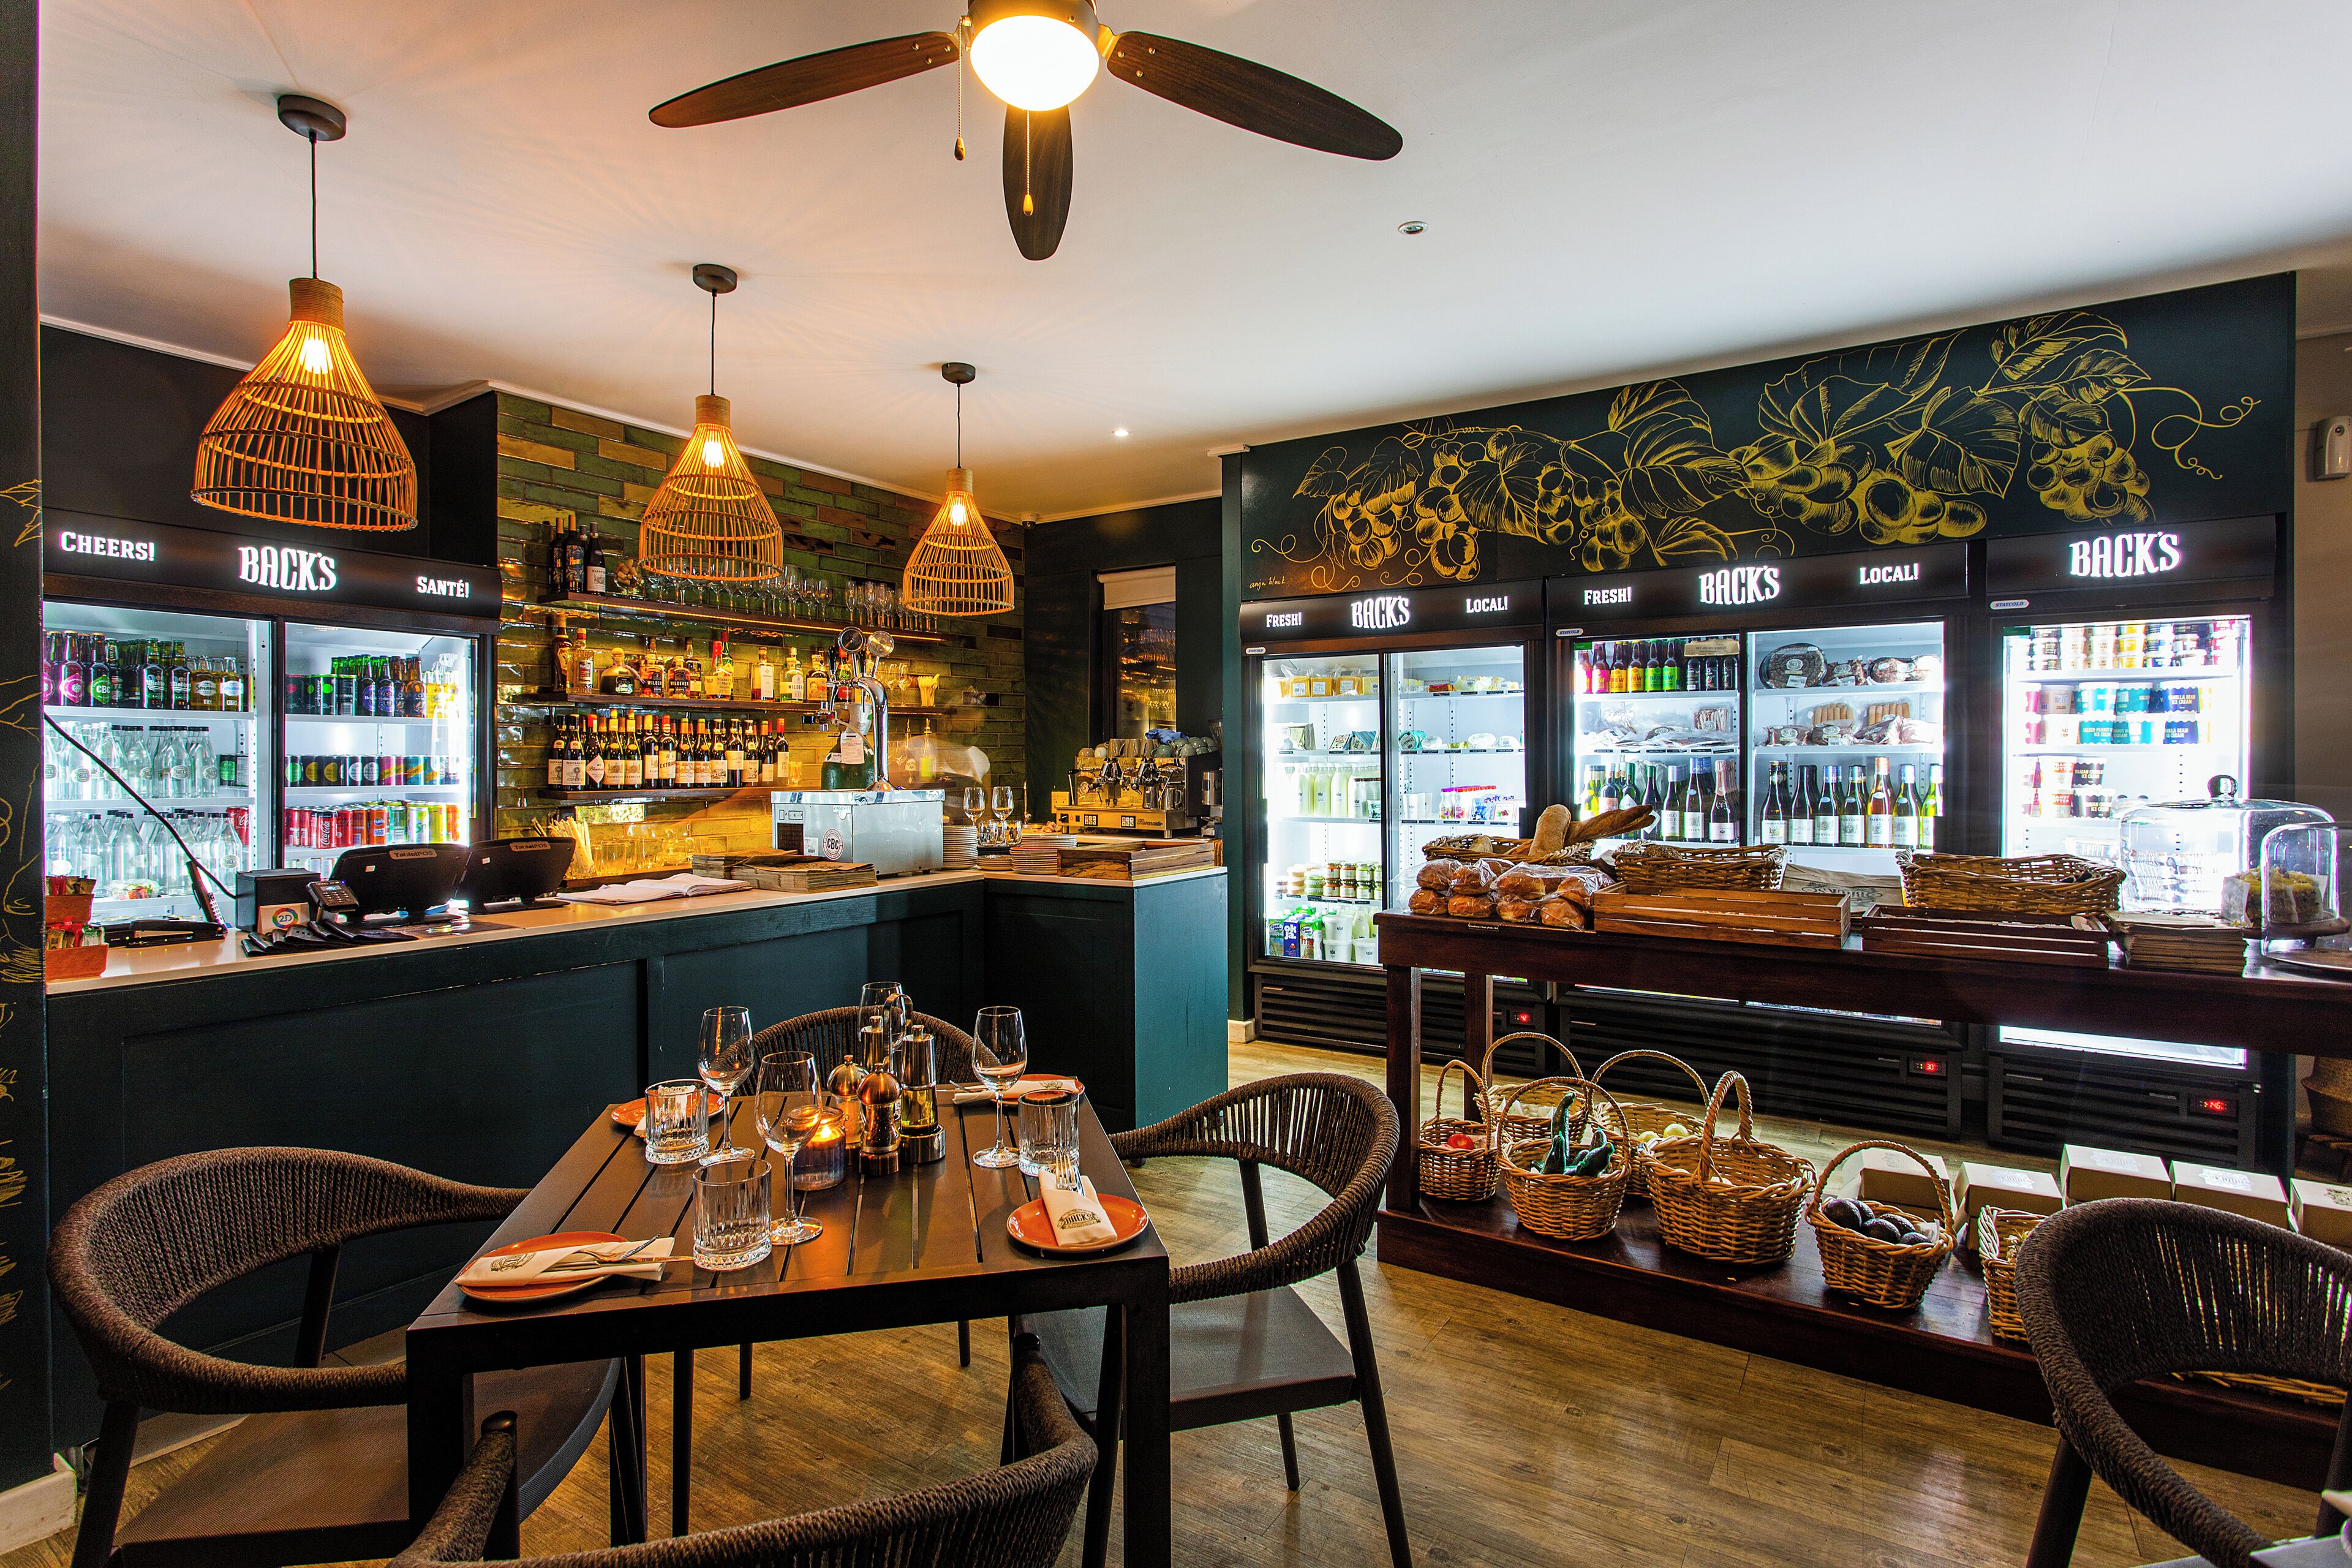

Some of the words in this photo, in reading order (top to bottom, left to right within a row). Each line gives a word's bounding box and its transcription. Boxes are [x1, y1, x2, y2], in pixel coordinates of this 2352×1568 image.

[60, 530, 155, 562] CHEERS!
[2069, 531, 2182, 578] BACK'S
[238, 546, 337, 591] BACK'S
[1860, 563, 1919, 584] LOCAL!
[417, 576, 470, 598] SANTÉ!
[1268, 575, 1286, 585] black
[1698, 565, 1780, 605] BACK'S
[1466, 595, 1509, 613] LOCAL!
[1583, 586, 1632, 605] FRESH!
[1265, 612, 1302, 628] FRESH!
[1351, 595, 1410, 629] BACK'S
[96, 685, 111, 694] CBC
[827, 838, 839, 850] CBC
